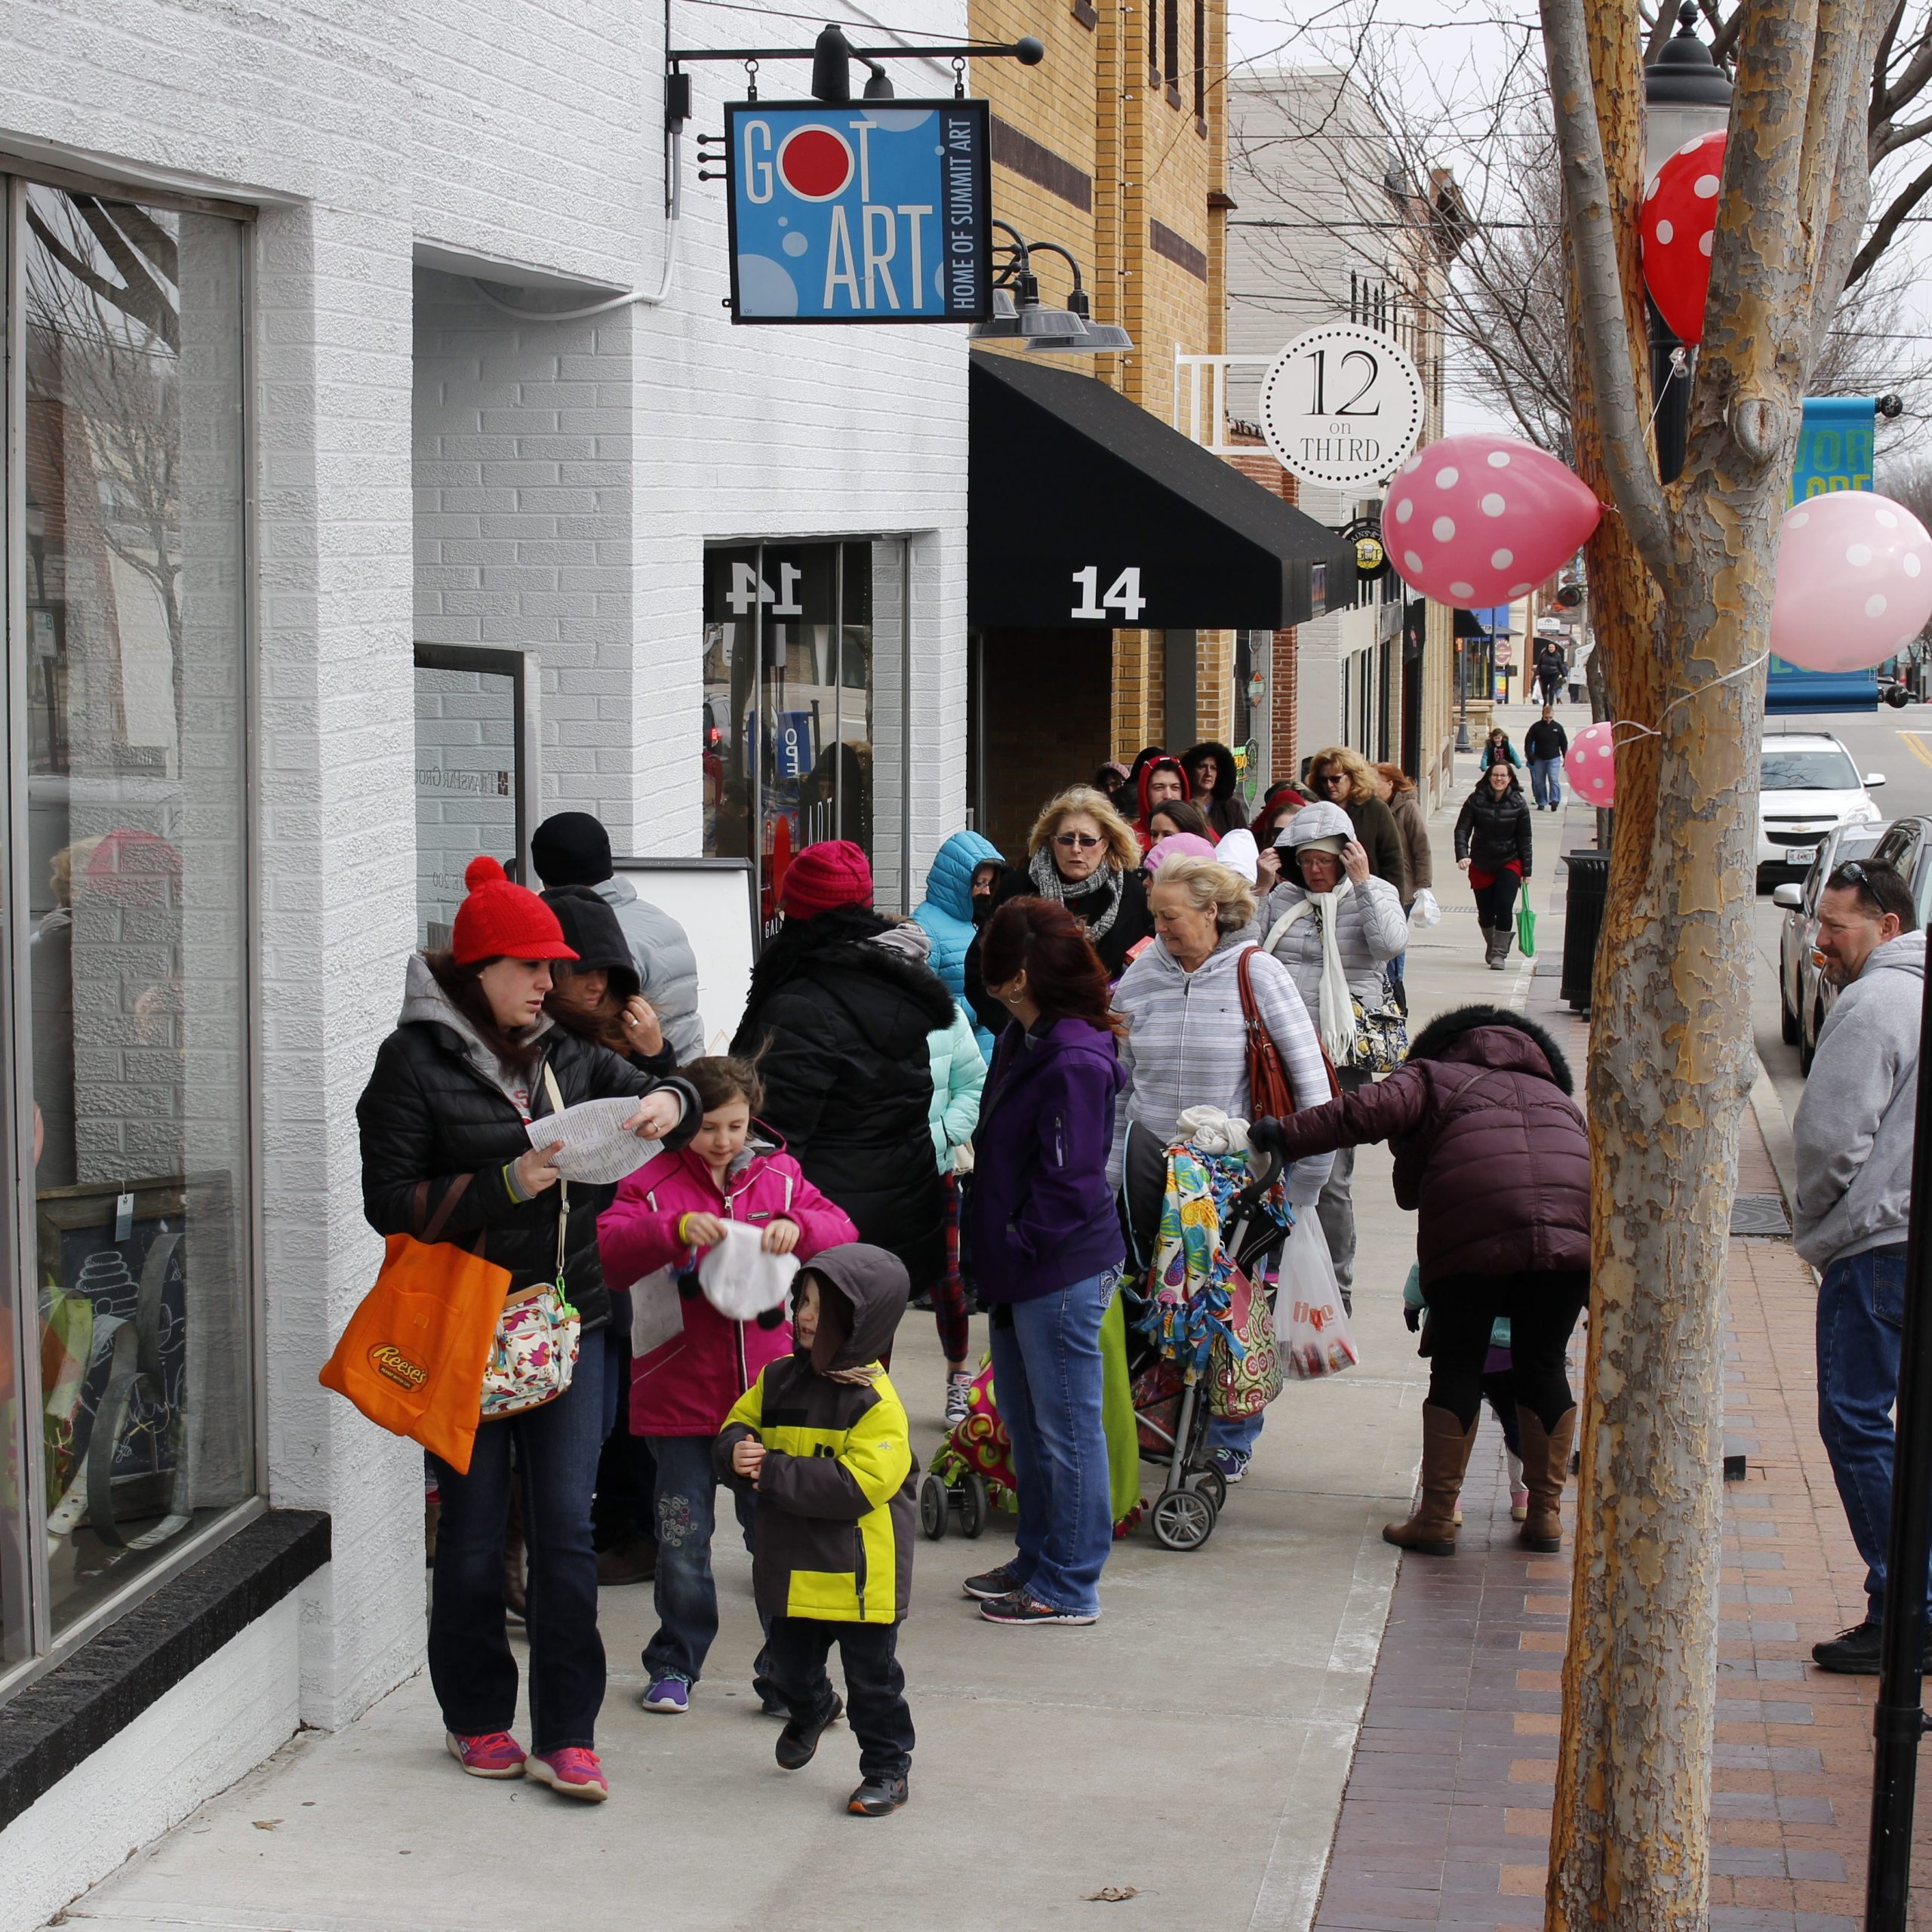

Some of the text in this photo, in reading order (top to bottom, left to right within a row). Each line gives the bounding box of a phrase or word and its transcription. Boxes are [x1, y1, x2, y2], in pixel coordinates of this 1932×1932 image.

[743, 120, 877, 205] GOT
[949, 118, 975, 309] HOME OF SUMMIT ART
[823, 205, 933, 309] ART
[1300, 349, 1381, 416] 12
[1300, 437, 1380, 462] THIRD
[1329, 421, 1352, 435] on
[1351, 531, 1369, 543] AINS
[1072, 566, 1146, 620] 14
